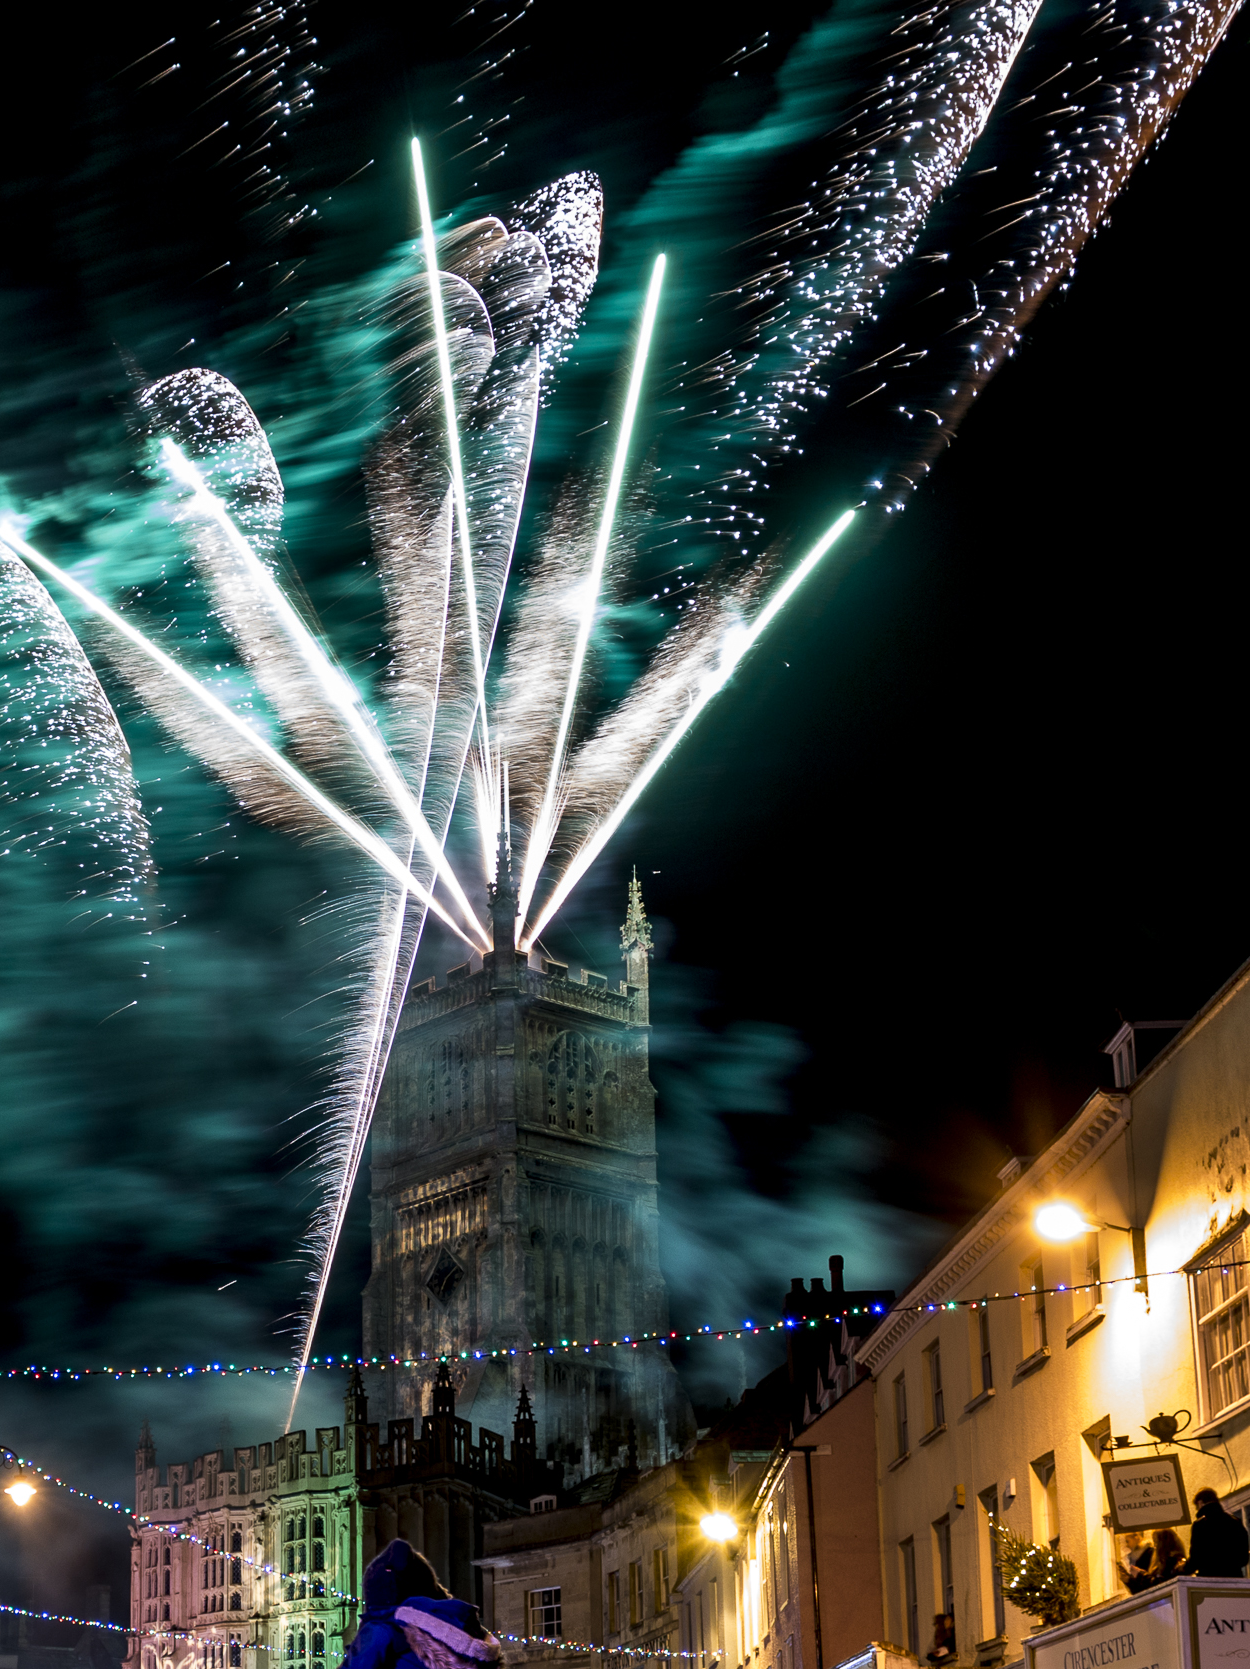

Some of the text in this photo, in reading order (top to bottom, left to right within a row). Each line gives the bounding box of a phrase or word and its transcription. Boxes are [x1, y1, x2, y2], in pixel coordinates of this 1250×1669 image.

[1116, 1472, 1172, 1490] ANTIQUES
[1142, 1489, 1151, 1498] &
[1118, 1498, 1179, 1512] COLLECTABLES
[1063, 1632, 1137, 1669] CIRENCESTER
